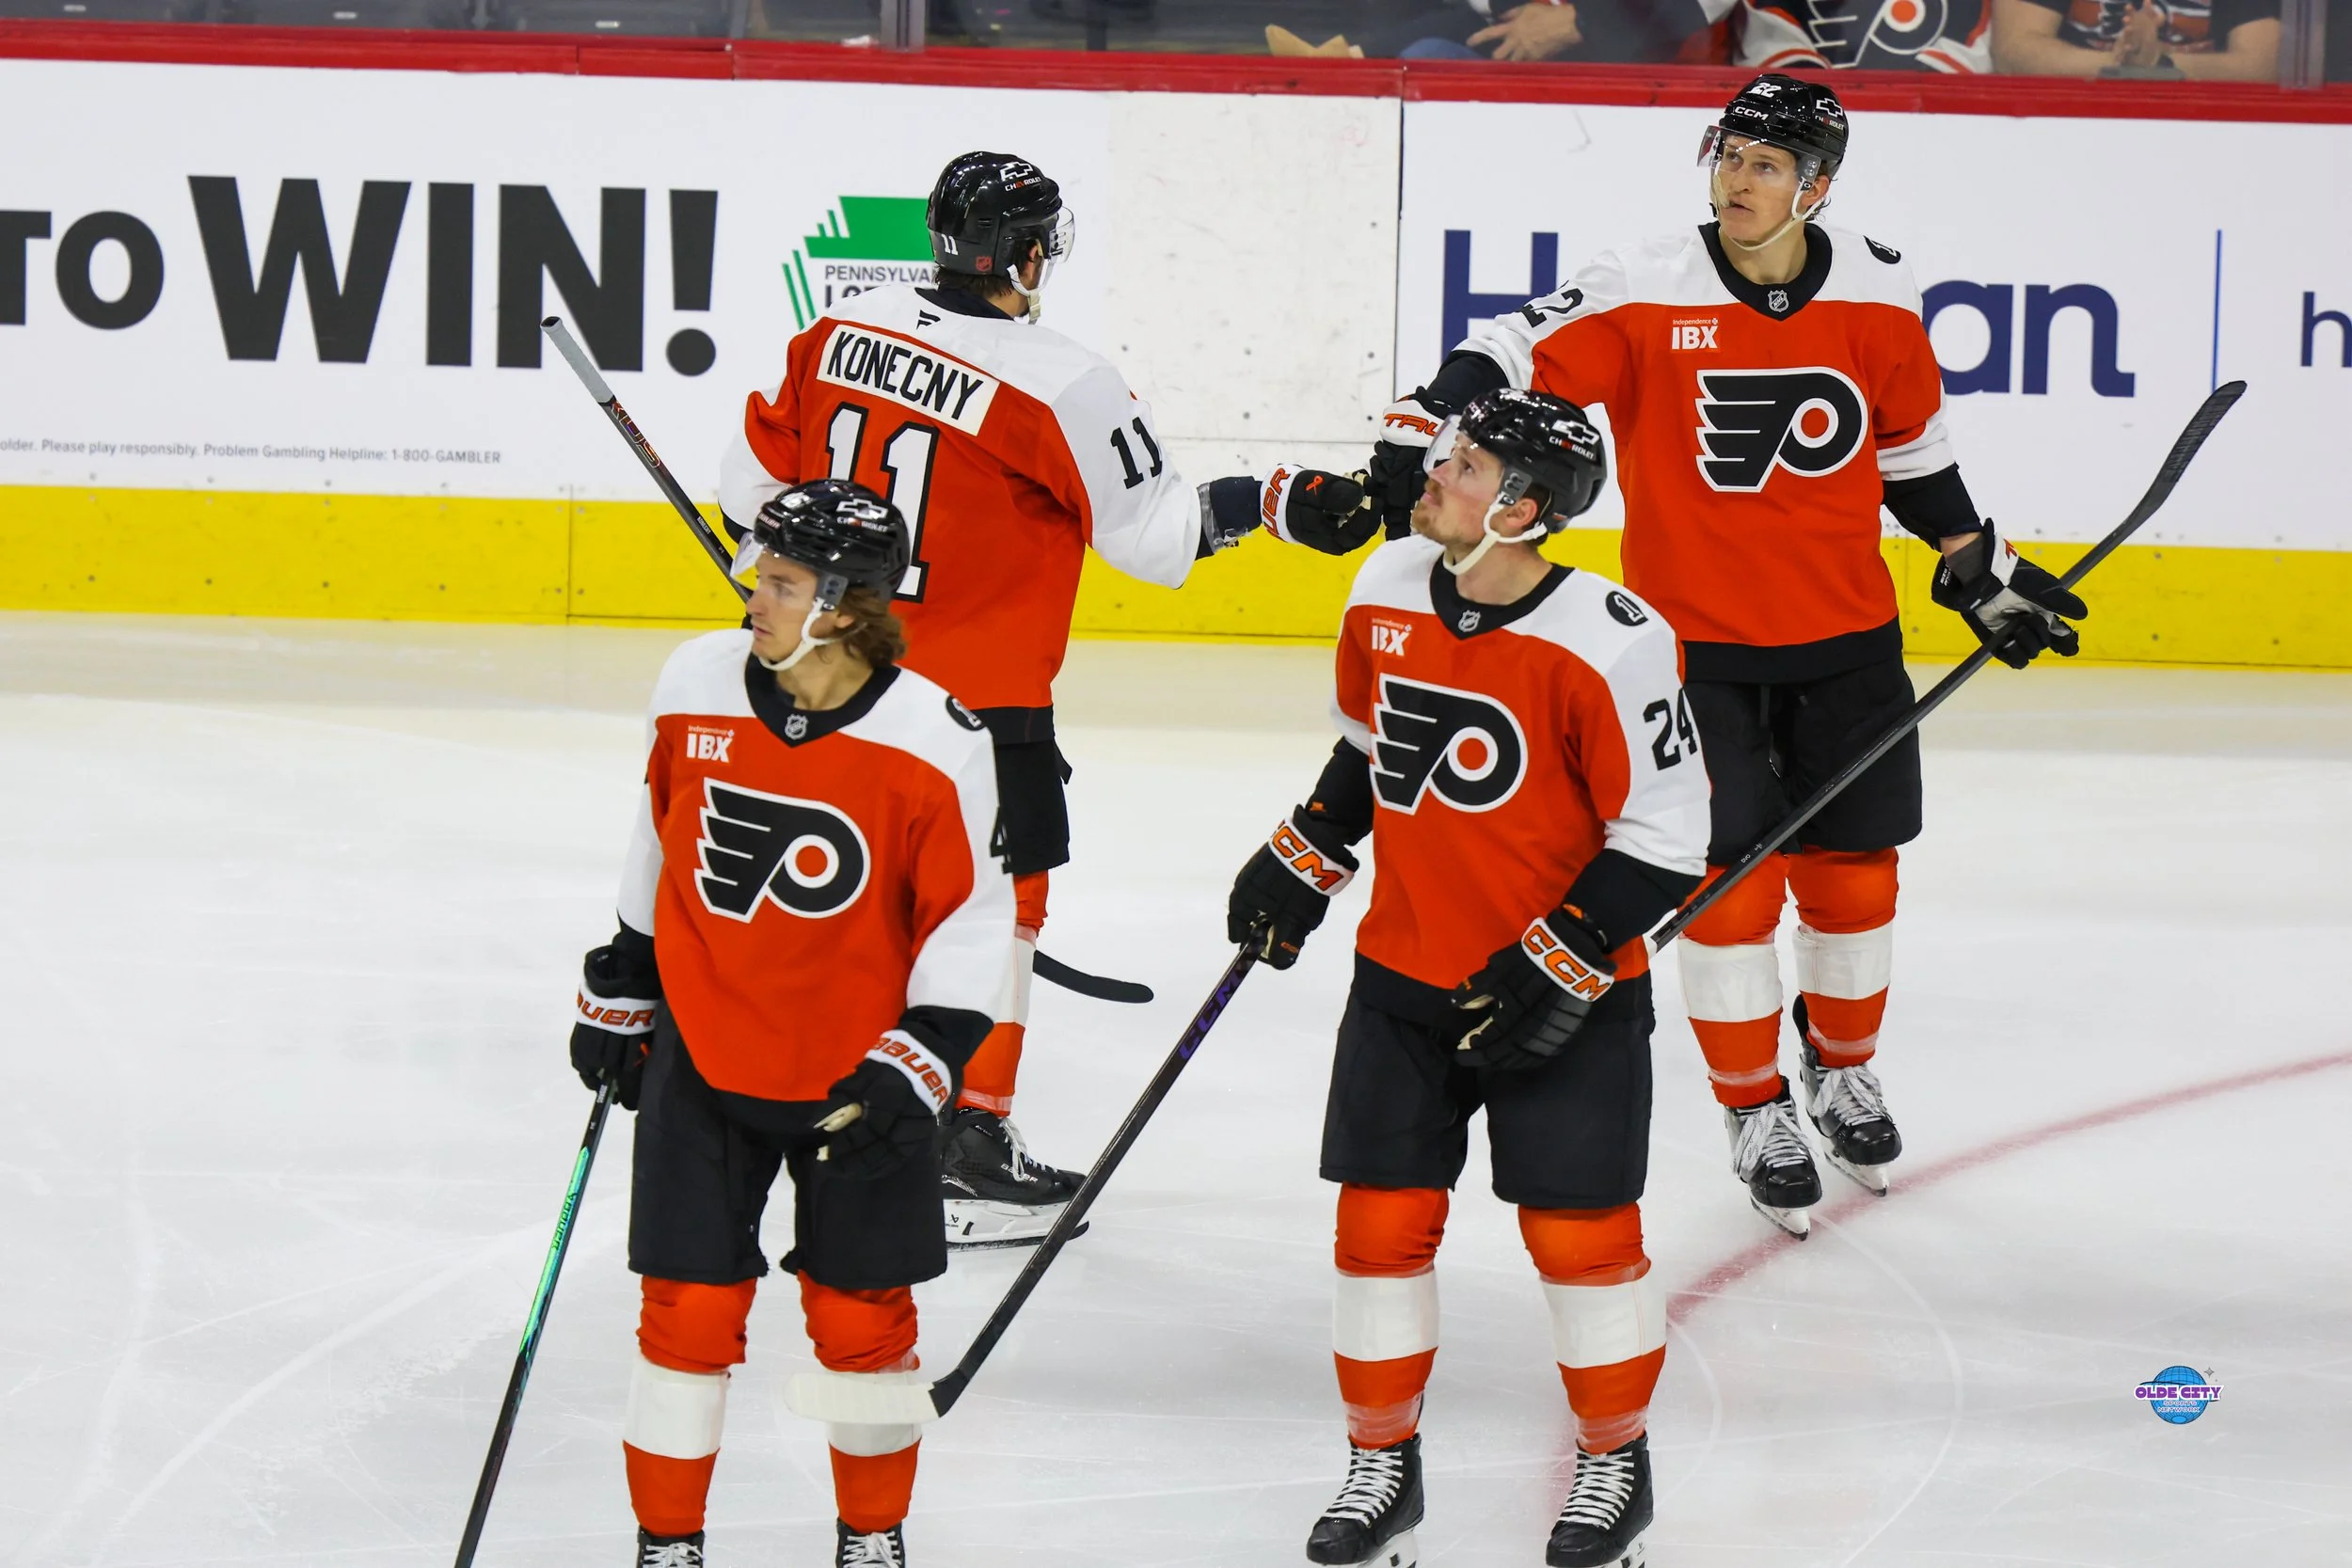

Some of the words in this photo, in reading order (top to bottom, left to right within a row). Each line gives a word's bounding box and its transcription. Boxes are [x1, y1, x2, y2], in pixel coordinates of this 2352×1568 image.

[1748, 82, 1783, 99] 22
[1734, 106, 1770, 121] CCM
[1004, 176, 1042, 192] CHEVROLET
[941, 233, 960, 257] 11
[186, 174, 719, 377] WIN!
[1521, 280, 1584, 328] 2
[1671, 325, 1719, 350] IBX
[1672, 318, 1712, 326] Independence
[826, 330, 983, 420] KONECNY
[41, 438, 86, 453] Please
[88, 441, 117, 457] play
[119, 441, 200, 458] responsibly.
[203, 443, 259, 457] Problem
[262, 445, 326, 461] Gambling
[329, 447, 388, 462] Helpline:
[391, 449, 501, 464] 1-800-GAMBLER
[1111, 415, 1164, 490] 11
[1262, 467, 1291, 539] UER
[1371, 625, 1411, 657] IBX
[1643, 687, 1698, 771] 24
[686, 733, 733, 764] IBX
[1270, 818, 1344, 892] CM
[1523, 924, 1612, 1001] CCM
[1000, 1162, 1039, 1183] BAER
